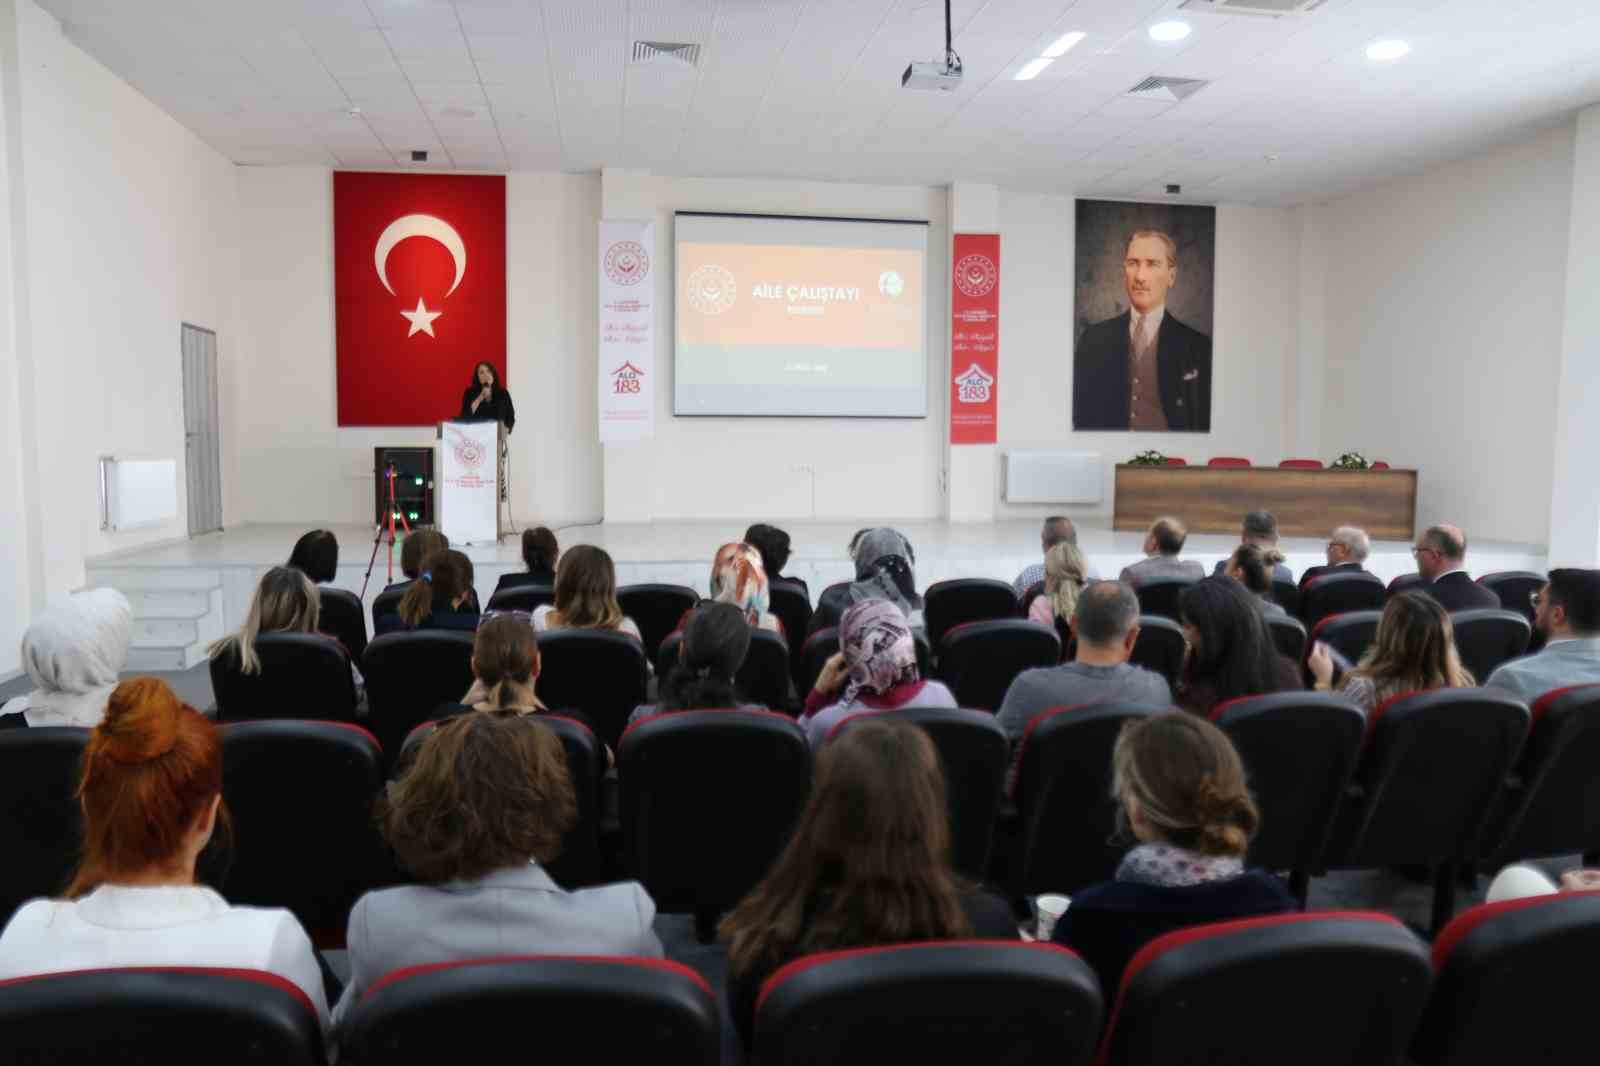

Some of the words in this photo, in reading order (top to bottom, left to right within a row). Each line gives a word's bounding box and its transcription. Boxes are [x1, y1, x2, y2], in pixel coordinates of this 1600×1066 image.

[752, 282, 784, 299] AİLE
[614, 379, 640, 393] 183
[962, 386, 986, 400] 183
